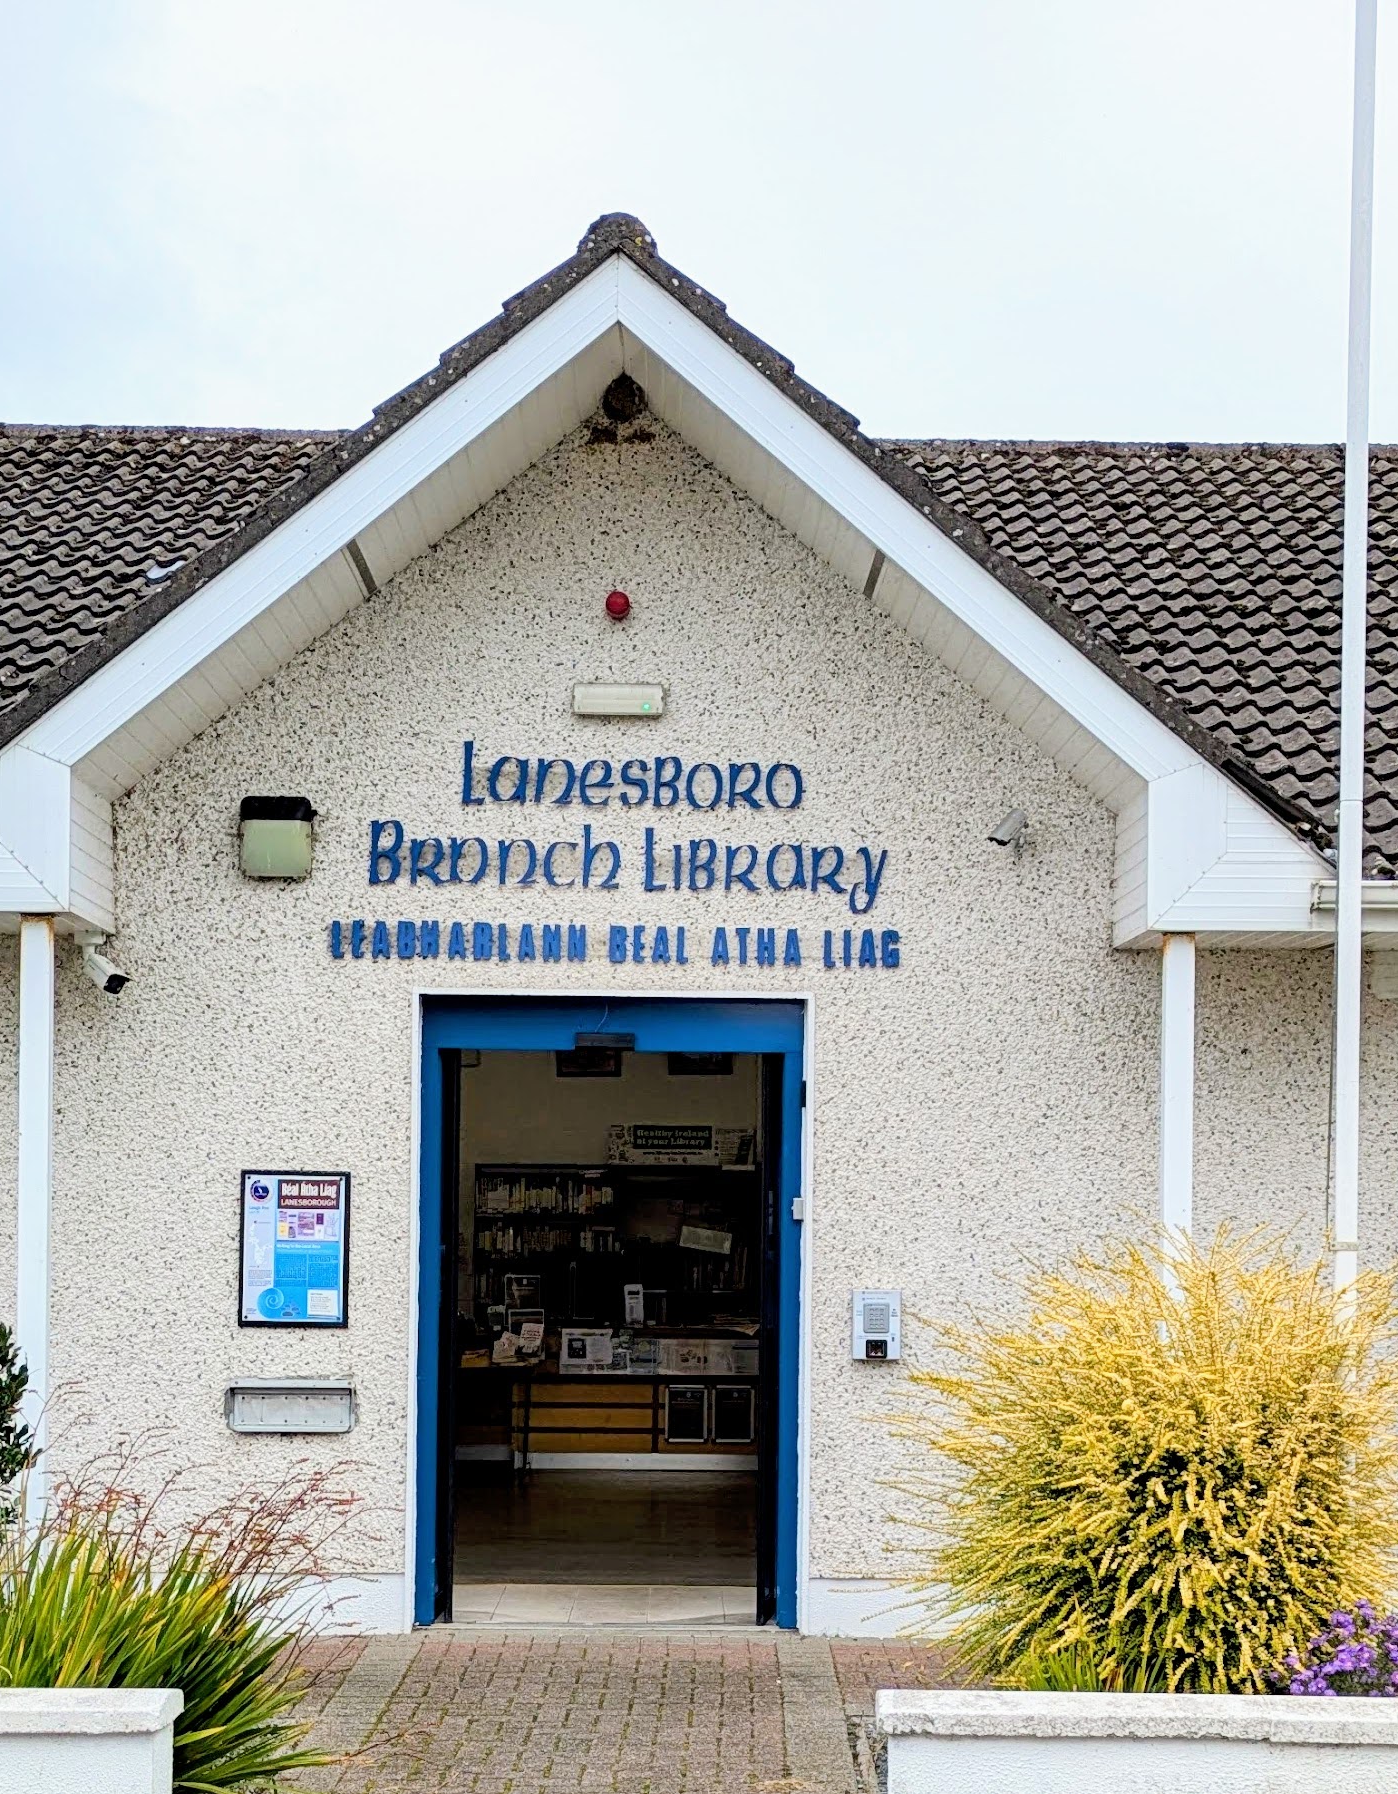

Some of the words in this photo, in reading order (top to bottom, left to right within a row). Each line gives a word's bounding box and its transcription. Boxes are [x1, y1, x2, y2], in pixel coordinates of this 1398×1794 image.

[330, 919, 587, 962] LEABHARLANN
[609, 924, 689, 964] BEAL
[710, 926, 803, 966] ATHA
[822, 928, 901, 968] LIAG
[280, 1198, 337, 1207] LANESBOROUGH
